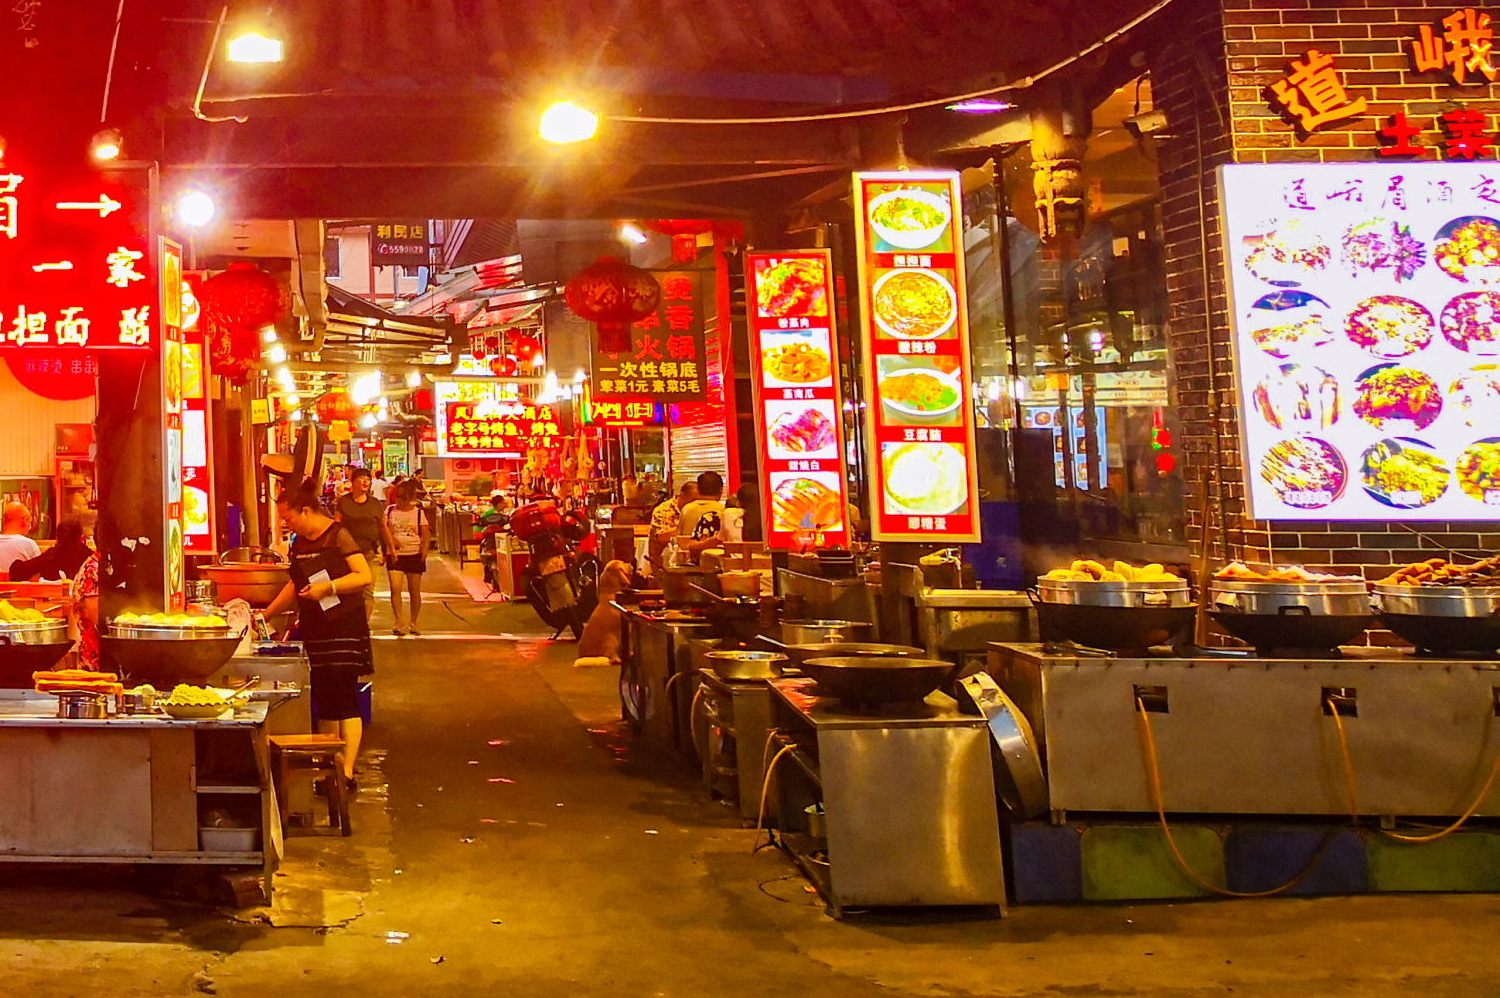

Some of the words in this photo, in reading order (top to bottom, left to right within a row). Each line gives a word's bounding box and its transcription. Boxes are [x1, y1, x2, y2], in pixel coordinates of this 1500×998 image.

[377, 225, 423, 239] 利民店
[893, 254, 932, 268] 担担面
[600, 362, 698, 378] 一次性锅底
